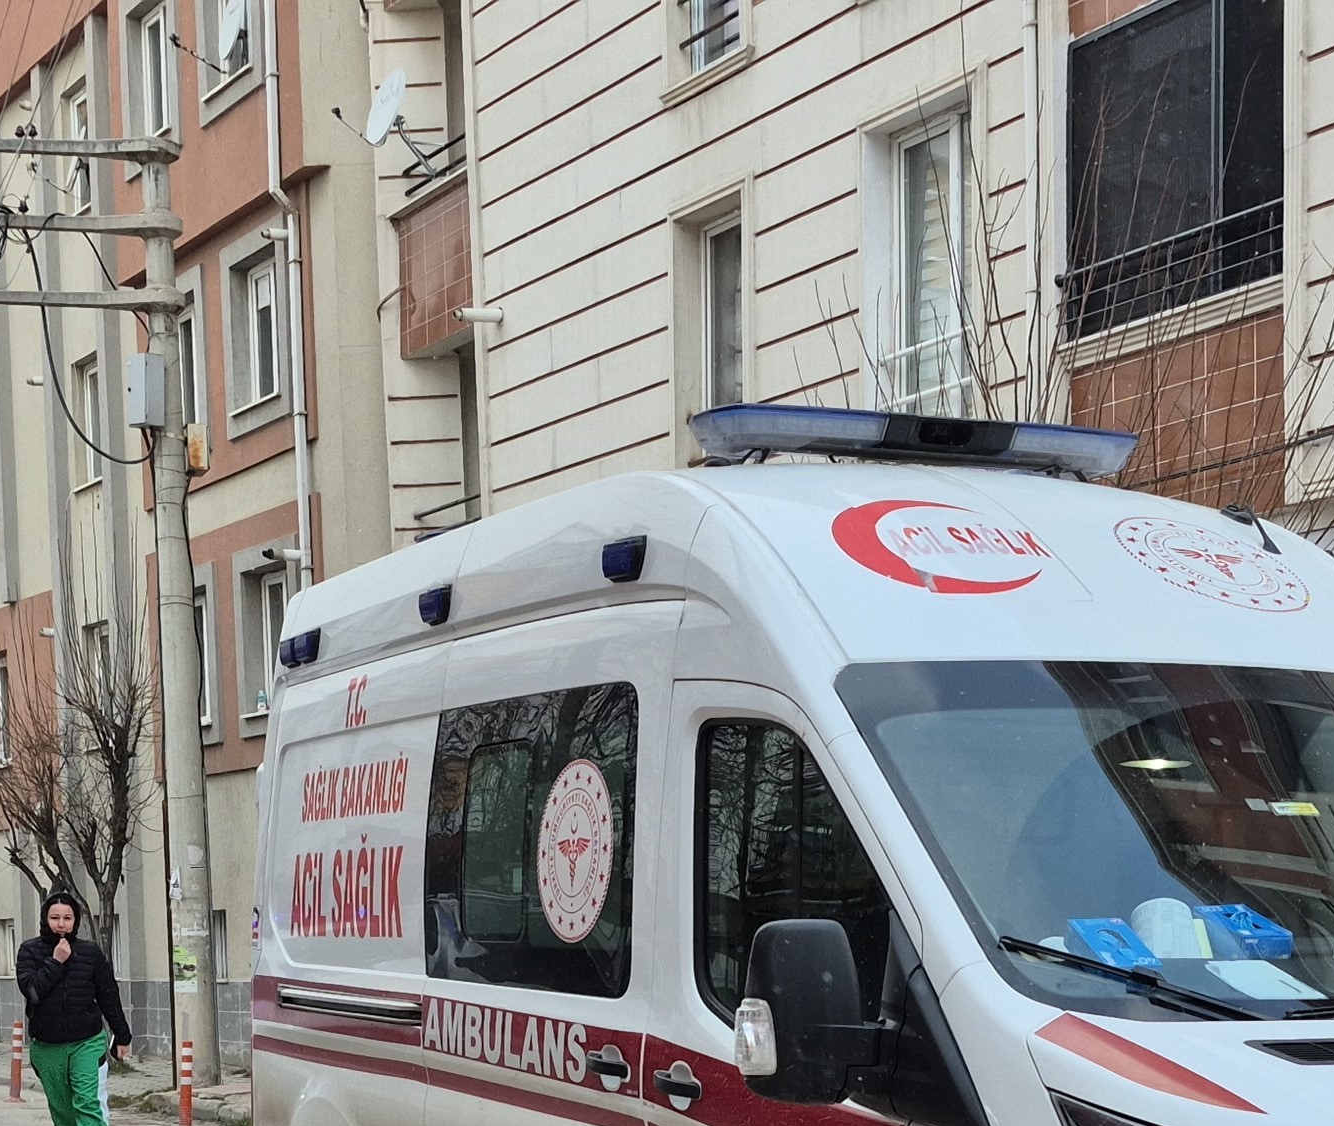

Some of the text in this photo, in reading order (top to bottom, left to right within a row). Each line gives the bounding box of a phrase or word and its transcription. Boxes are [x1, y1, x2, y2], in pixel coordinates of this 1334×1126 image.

[302, 751, 409, 824] SAĞLIK BAKANLIĞI
[332, 833, 404, 939] SAĞLIK
[424, 997, 588, 1084] AMBULANS
